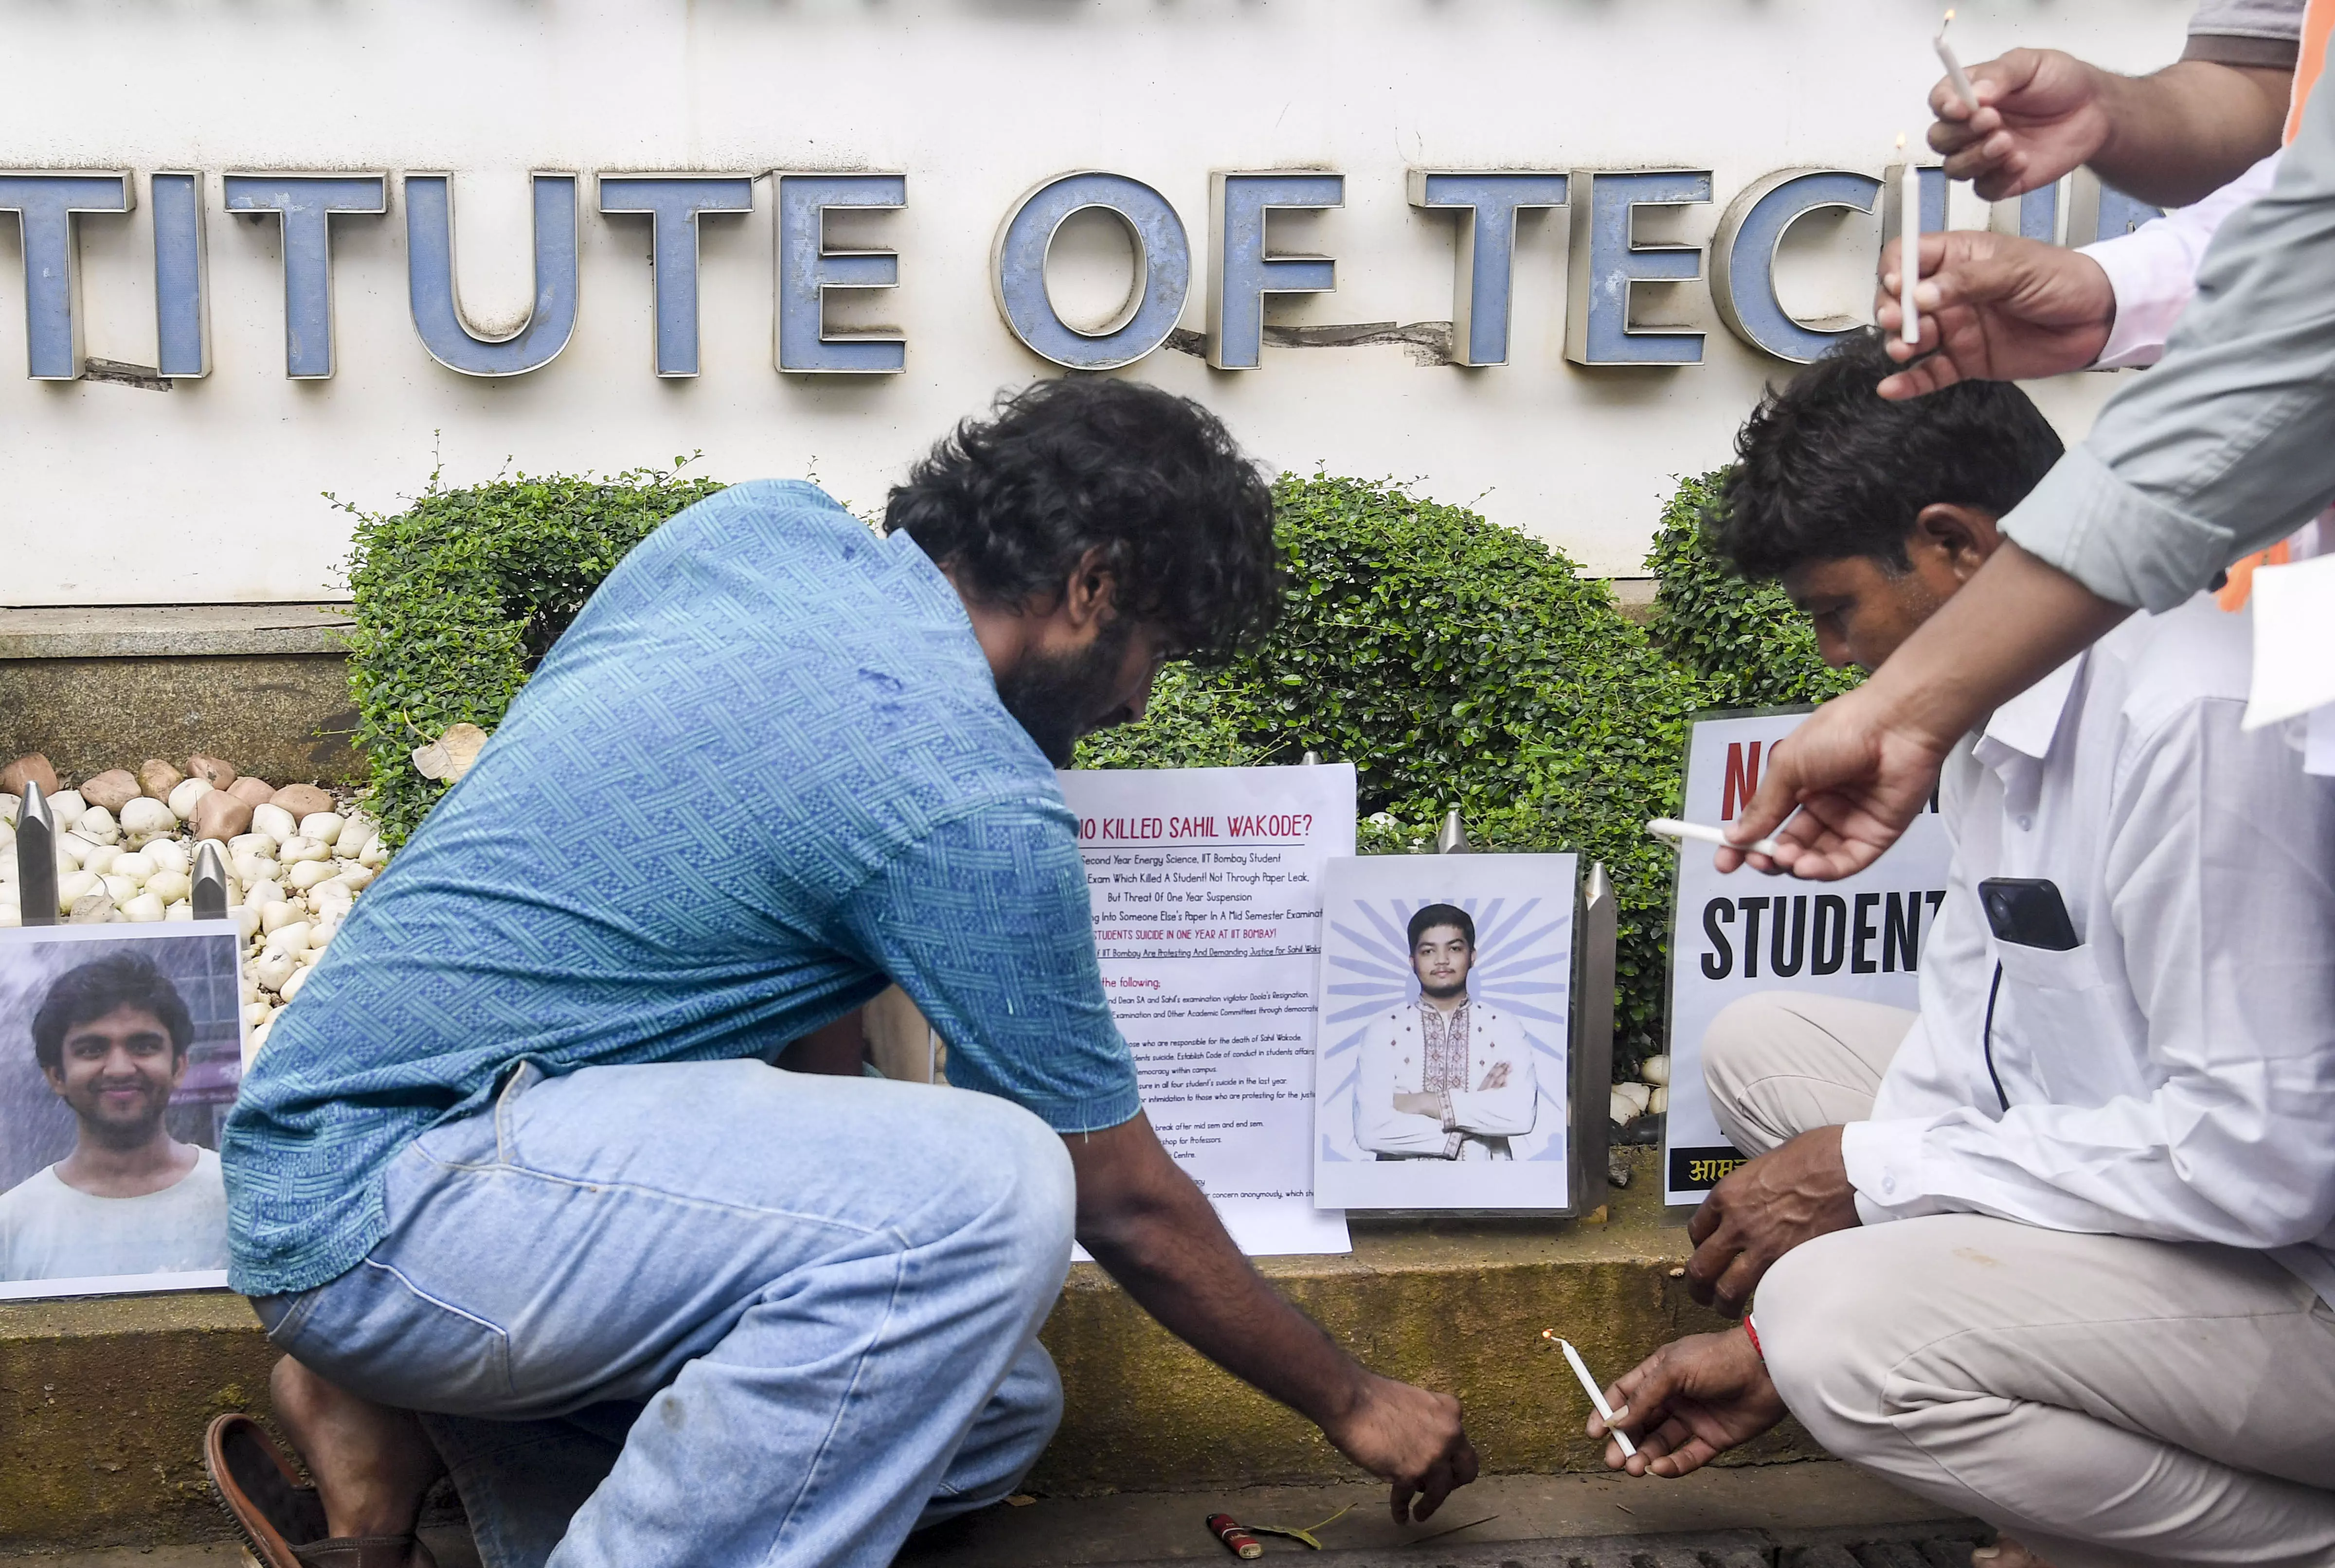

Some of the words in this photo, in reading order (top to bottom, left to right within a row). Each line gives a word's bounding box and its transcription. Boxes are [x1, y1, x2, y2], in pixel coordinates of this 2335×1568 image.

[0, 169, 908, 381] TITUTE
[990, 169, 1346, 371] OF
[1408, 167, 2165, 370] TEC
[1721, 739, 1784, 820] N
[1080, 818, 1096, 839] O
[1103, 818, 1162, 839] KILLED
[1169, 817, 1219, 837] SAHIL
[1227, 814, 1312, 837] WAKODE?
[1114, 855, 1132, 864] Year
[1134, 855, 1163, 866] Energy
[1166, 854, 1199, 864] Science,
[1202, 854, 1211, 863] IIT
[1214, 853, 1247, 865] Bombay
[1250, 853, 1280, 863] Student
[1088, 874, 1110, 884] Exam
[1113, 873, 1137, 883] Which
[1140, 873, 1161, 883] Killed
[1164, 873, 1170, 883] A
[1173, 872, 1206, 883] Student!
[1210, 873, 1222, 882] Not
[1226, 872, 1260, 885] Through
[1263, 872, 1285, 885] Paper
[1108, 892, 1121, 902] But
[1124, 892, 1151, 902] Threat
[1155, 892, 1164, 902] Of
[1167, 892, 1183, 901] One
[1186, 891, 1203, 901] Year
[1207, 891, 1252, 904] Suspension
[1102, 911, 1116, 921] Into
[1119, 911, 1158, 921] Someone
[1161, 910, 1182, 921] Else's
[1185, 911, 1207, 924] Paper
[1210, 910, 1217, 920] In
[1220, 911, 1226, 920] A
[1229, 910, 1242, 920] Mid
[1245, 910, 1284, 920] Semester
[1287, 908, 1323, 919] Examinat
[1136, 930, 1164, 940] SUICIDE
[1167, 930, 1173, 939] IN
[1176, 929, 1191, 939] ONE
[1195, 929, 1215, 939] YEAR
[1218, 929, 1228, 939] AT
[1231, 929, 1240, 939] IIT
[1243, 928, 1276, 939] BOMBAY!
[1113, 949, 1140, 959] Bombay
[1158, 948, 1191, 958] Protesting
[1209, 948, 1247, 958] Demanding
[1250, 947, 1273, 956] Justice
[1102, 977, 1116, 987] the
[1183, 995, 1221, 1003] examination
[1223, 994, 1248, 1003] vigilator
[1112, 1011, 1151, 1019] Examination
[1187, 1009, 1218, 1017] Academic
[1221, 1007, 1257, 1016] Committees
[1258, 1006, 1282, 1015] through
[1170, 1038, 1206, 1048] responsible
[1177, 1051, 1203, 1060] Establish
[1233, 1049, 1257, 1057] conduct
[1186, 1078, 1214, 1087] student's
[1149, 1094, 1185, 1103] intimidation
[1241, 1091, 1275, 1101] protesting
[1155, 1123, 1173, 1131] break
[1175, 1122, 1192, 1131] after
[1194, 1121, 1205, 1129] mid
[1236, 1120, 1248, 1128] end
[1160, 1138, 1177, 1147] shop
